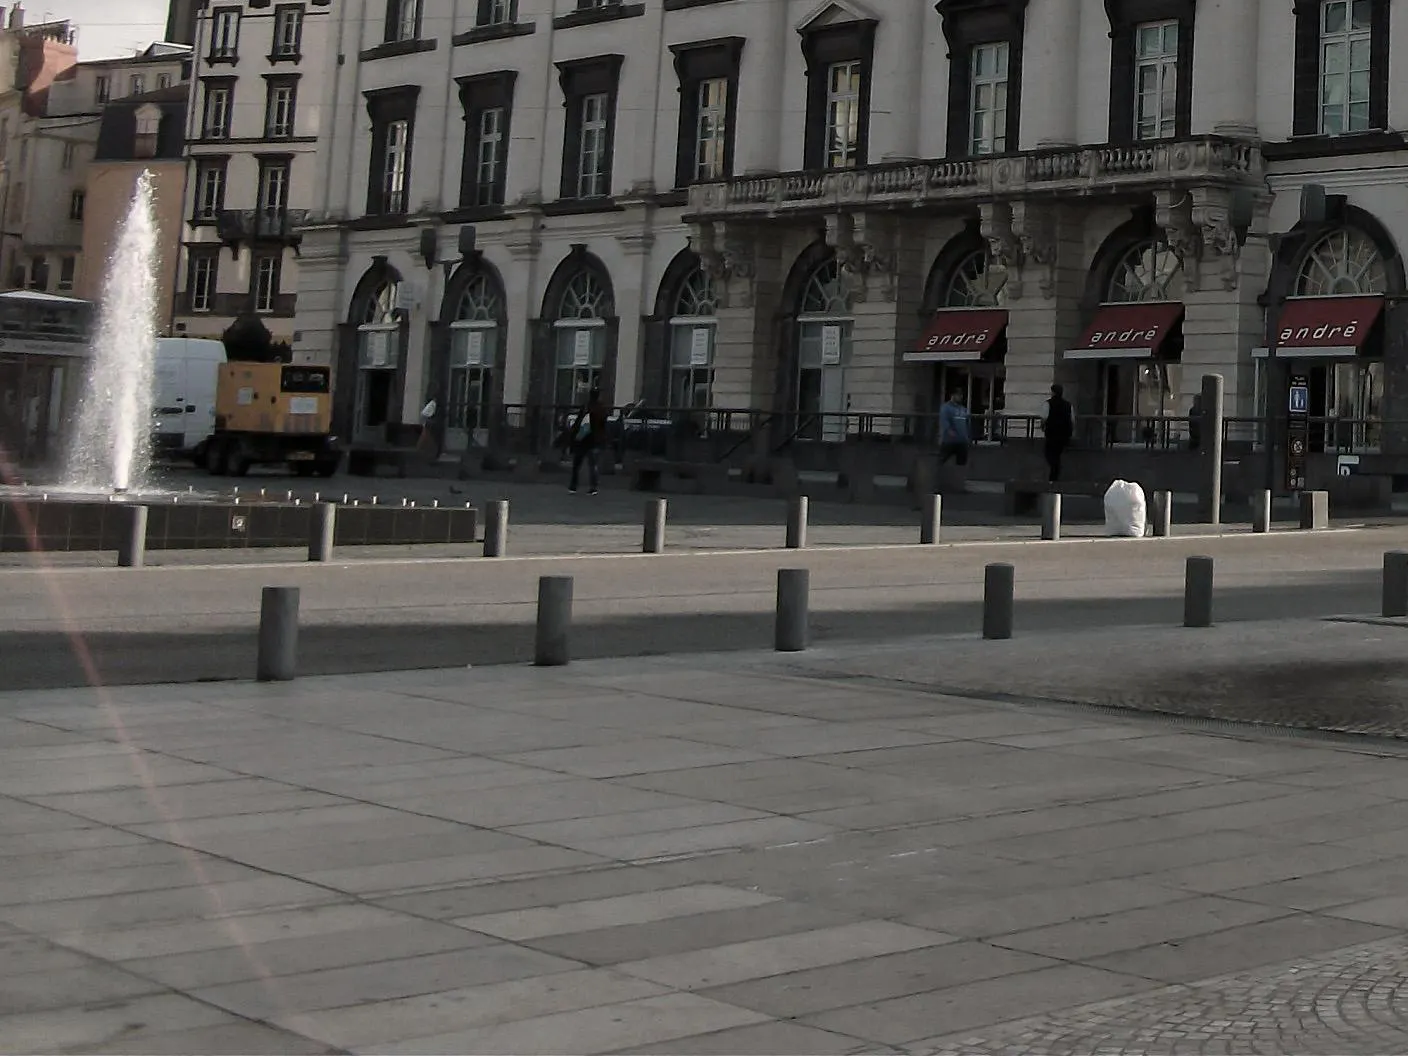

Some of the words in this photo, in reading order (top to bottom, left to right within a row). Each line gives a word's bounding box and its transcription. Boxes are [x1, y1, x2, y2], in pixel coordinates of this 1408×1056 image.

[925, 329, 989, 350] andré
[1088, 325, 1159, 347] andré
[1278, 320, 1358, 345] andré
